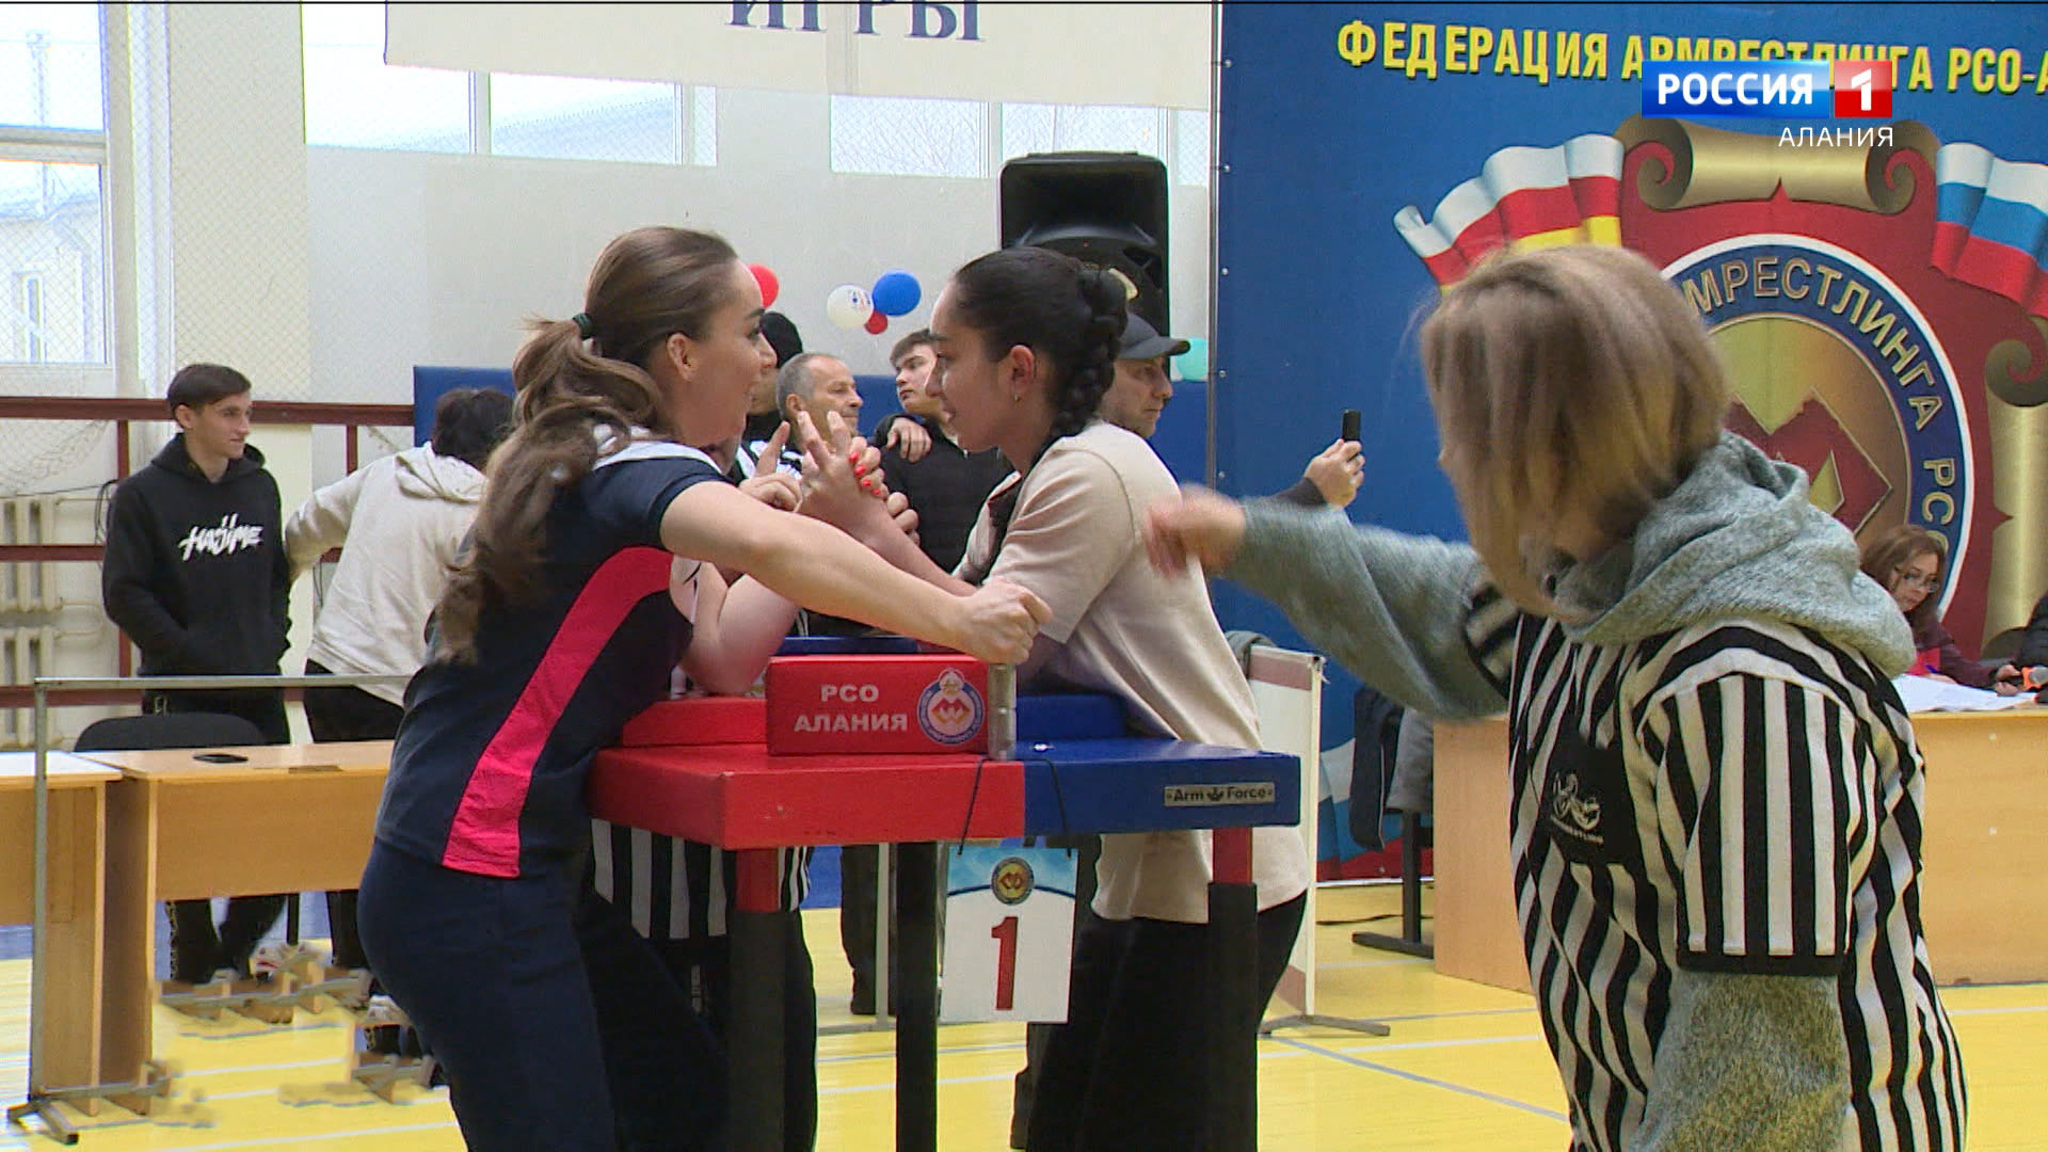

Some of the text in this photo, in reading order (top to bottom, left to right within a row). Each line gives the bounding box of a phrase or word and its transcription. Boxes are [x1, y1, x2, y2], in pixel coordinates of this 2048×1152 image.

[1337, 20, 1608, 86] ФЕДЕРАЦИЯ
[820, 684, 879, 702] РСО
[793, 713, 908, 732] АЛАНИЯ
[1173, 786, 1266, 801] Arm Force
[992, 916, 1018, 1011] 1
